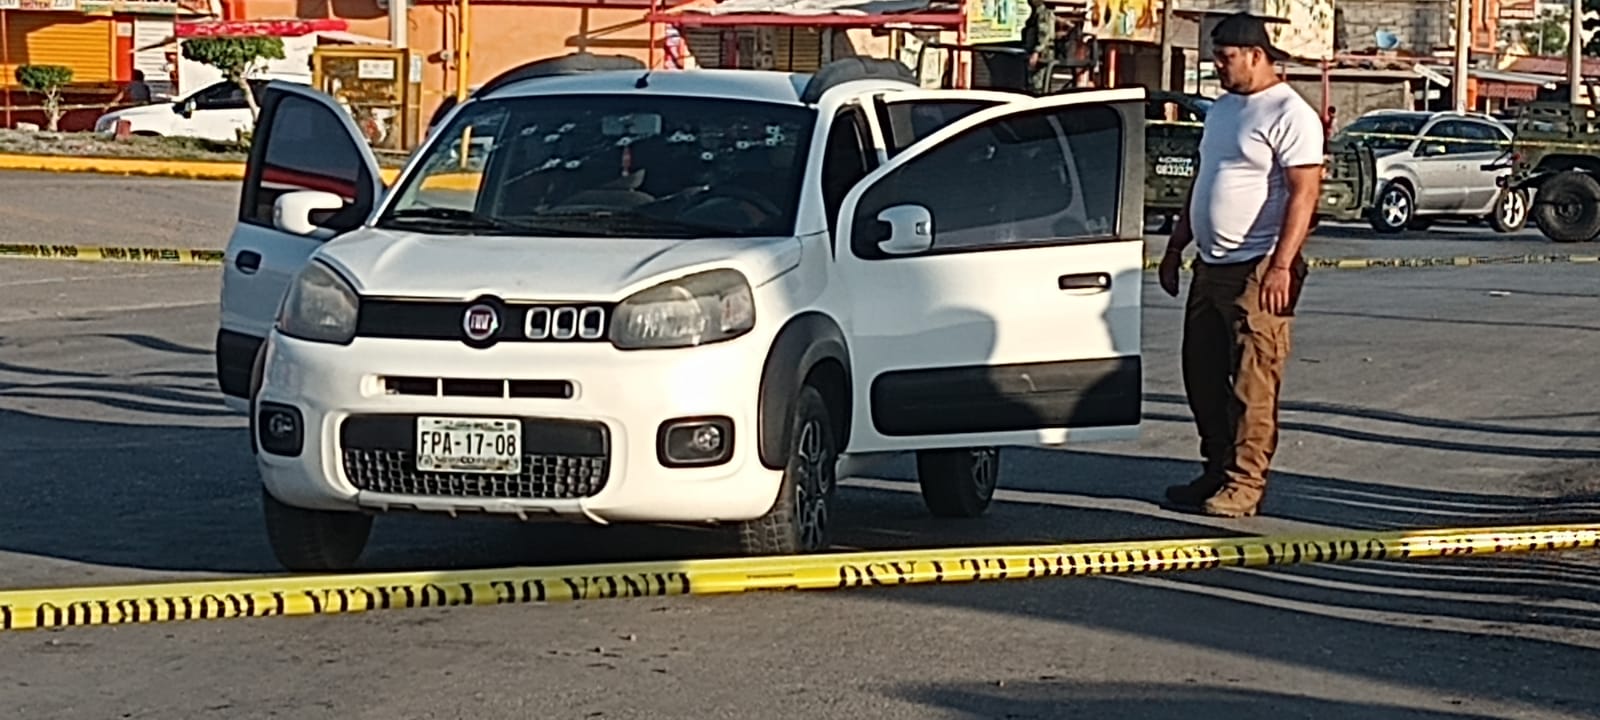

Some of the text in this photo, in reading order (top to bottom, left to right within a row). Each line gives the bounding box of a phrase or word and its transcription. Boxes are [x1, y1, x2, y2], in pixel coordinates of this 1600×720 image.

[52, 245, 78, 257] PASO
[99, 247, 125, 259] LINEA
[421, 431, 516, 456] FPA-17-08
[305, 583, 473, 613] POLICIA
[490, 579, 546, 604] DE
[561, 572, 690, 600] LINEA
[37, 591, 284, 627] PROHIBIDO
